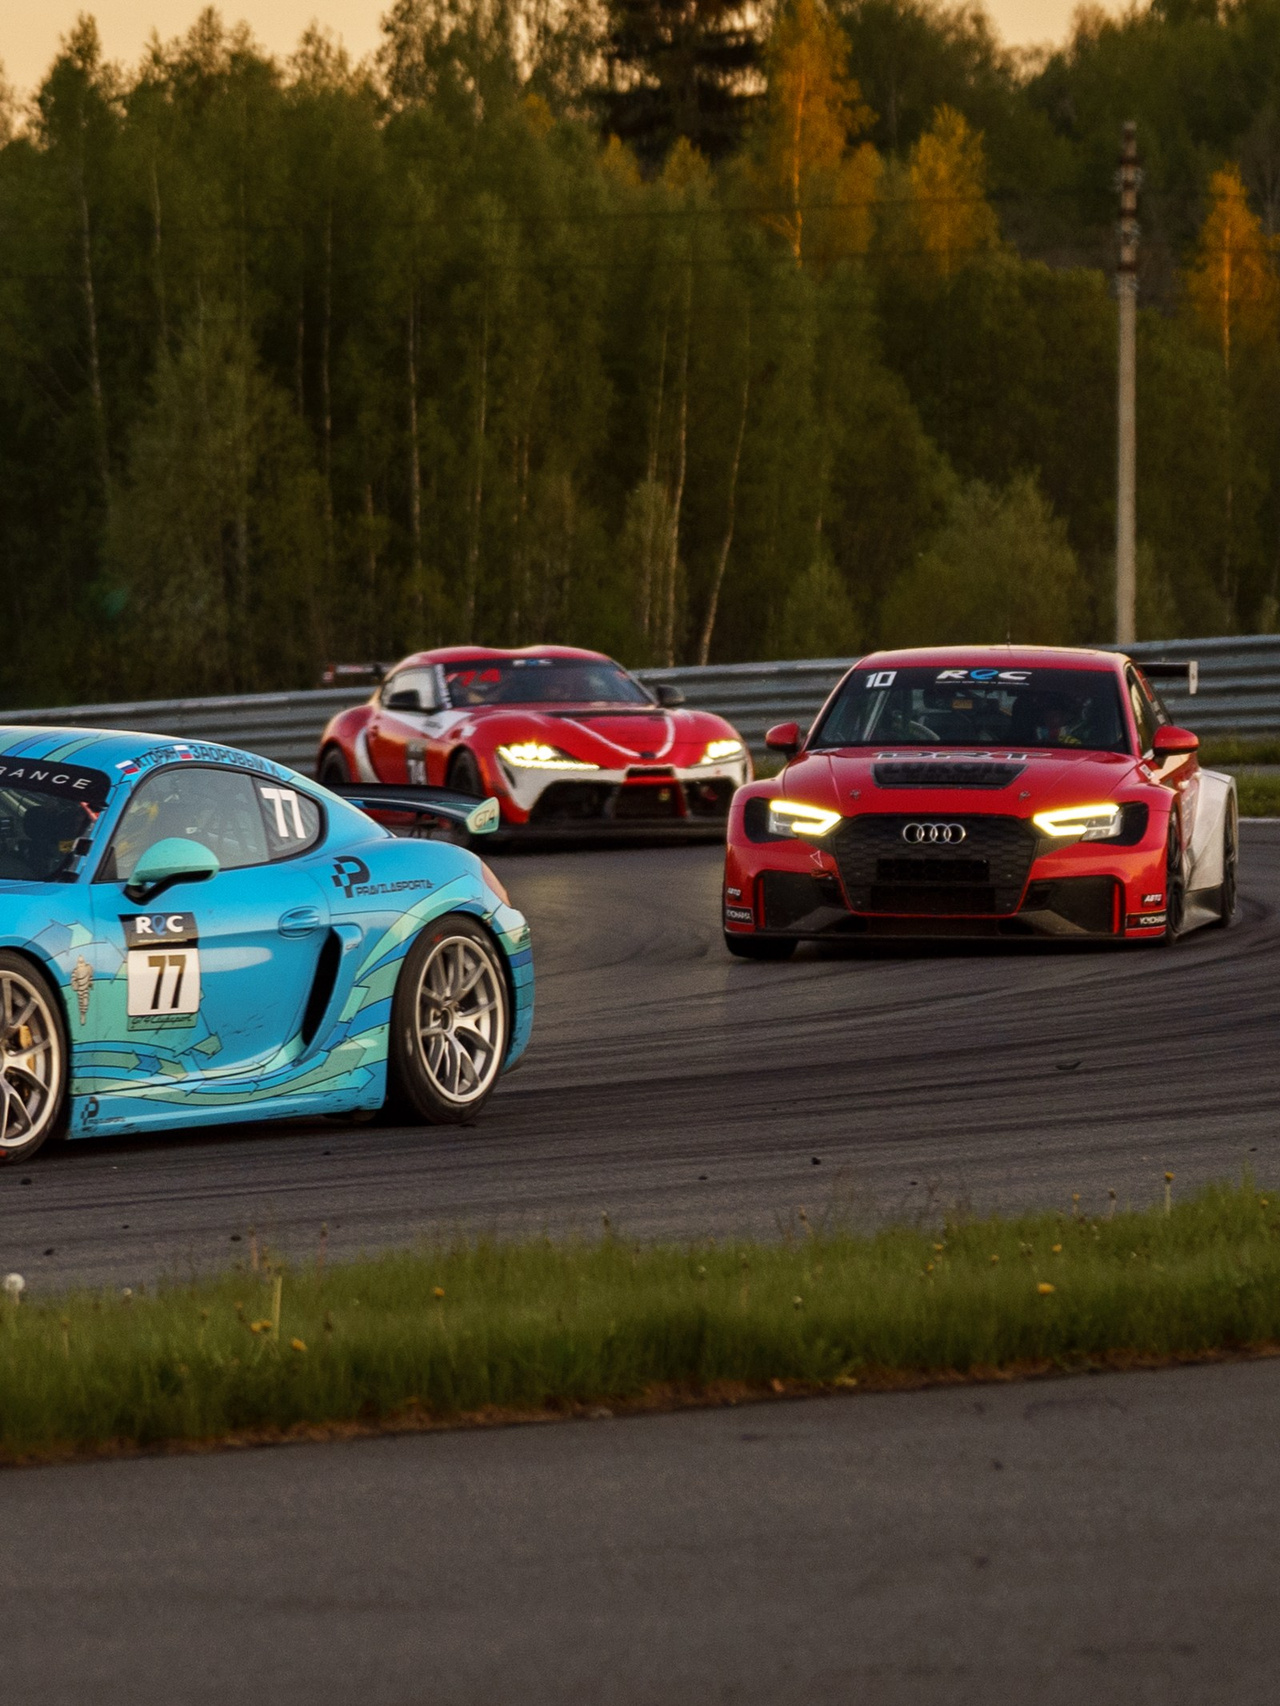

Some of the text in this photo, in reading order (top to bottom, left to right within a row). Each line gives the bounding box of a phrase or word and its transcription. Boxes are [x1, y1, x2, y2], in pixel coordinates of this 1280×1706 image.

[866, 671, 897, 688] 10
[260, 787, 306, 839] 77
[147, 954, 187, 1010] 77
